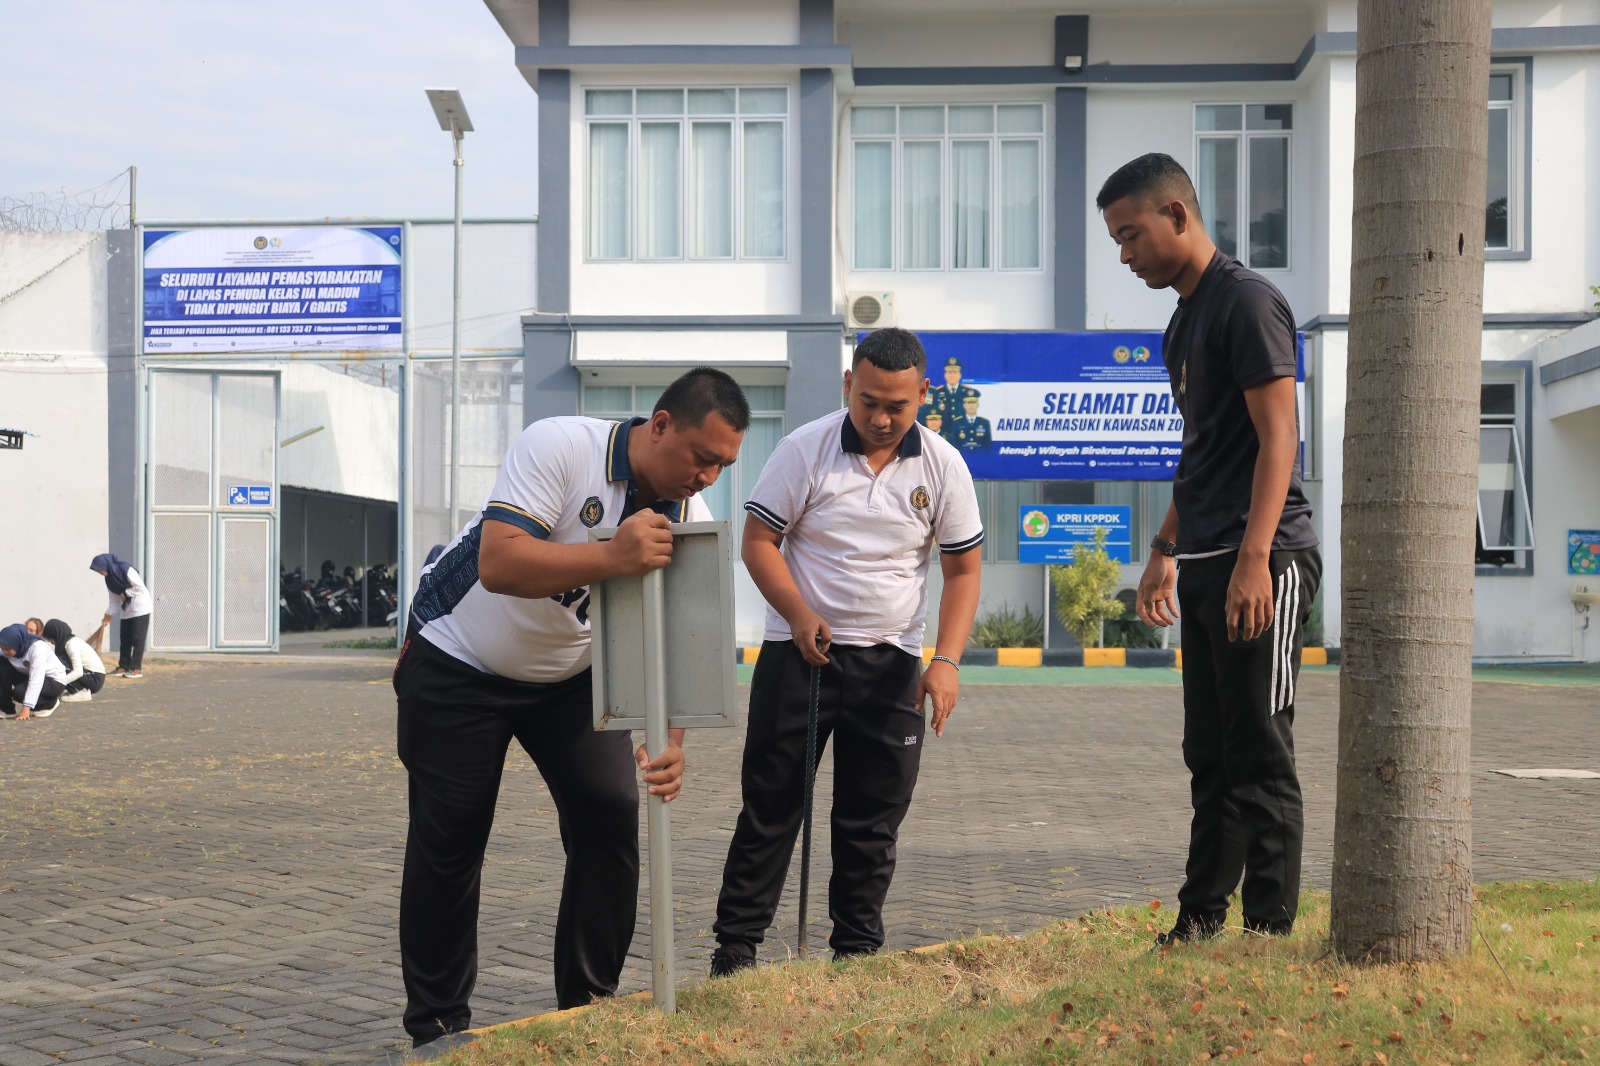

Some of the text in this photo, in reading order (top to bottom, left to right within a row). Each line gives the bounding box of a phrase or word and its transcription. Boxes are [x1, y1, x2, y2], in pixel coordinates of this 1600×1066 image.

[160, 270, 383, 287] SELURUH LAYANAN PEMASYARAKATAN
[176, 290, 189, 302] DI
[189, 289, 222, 301] LAPAS
[223, 289, 266, 300] PEMUDA
[267, 288, 300, 299] KELAS
[317, 287, 360, 299] MADIUN
[184, 304, 216, 315] TIDAK
[216, 303, 270, 315] DIPUNGUT
[270, 302, 301, 314] BIAYA
[309, 302, 348, 313] GRATIS
[1042, 393, 1139, 415] SELAMAT
[997, 419, 1031, 432] ANDA
[1033, 419, 1099, 432] MEMASUKI
[1103, 419, 1166, 432] KAWASAN
[999, 445, 1182, 456] Menuju Wilayah Birokrasi Bersih Dan
[230, 488, 238, 497] P
[1057, 514, 1120, 523] KPRI KPPDK
